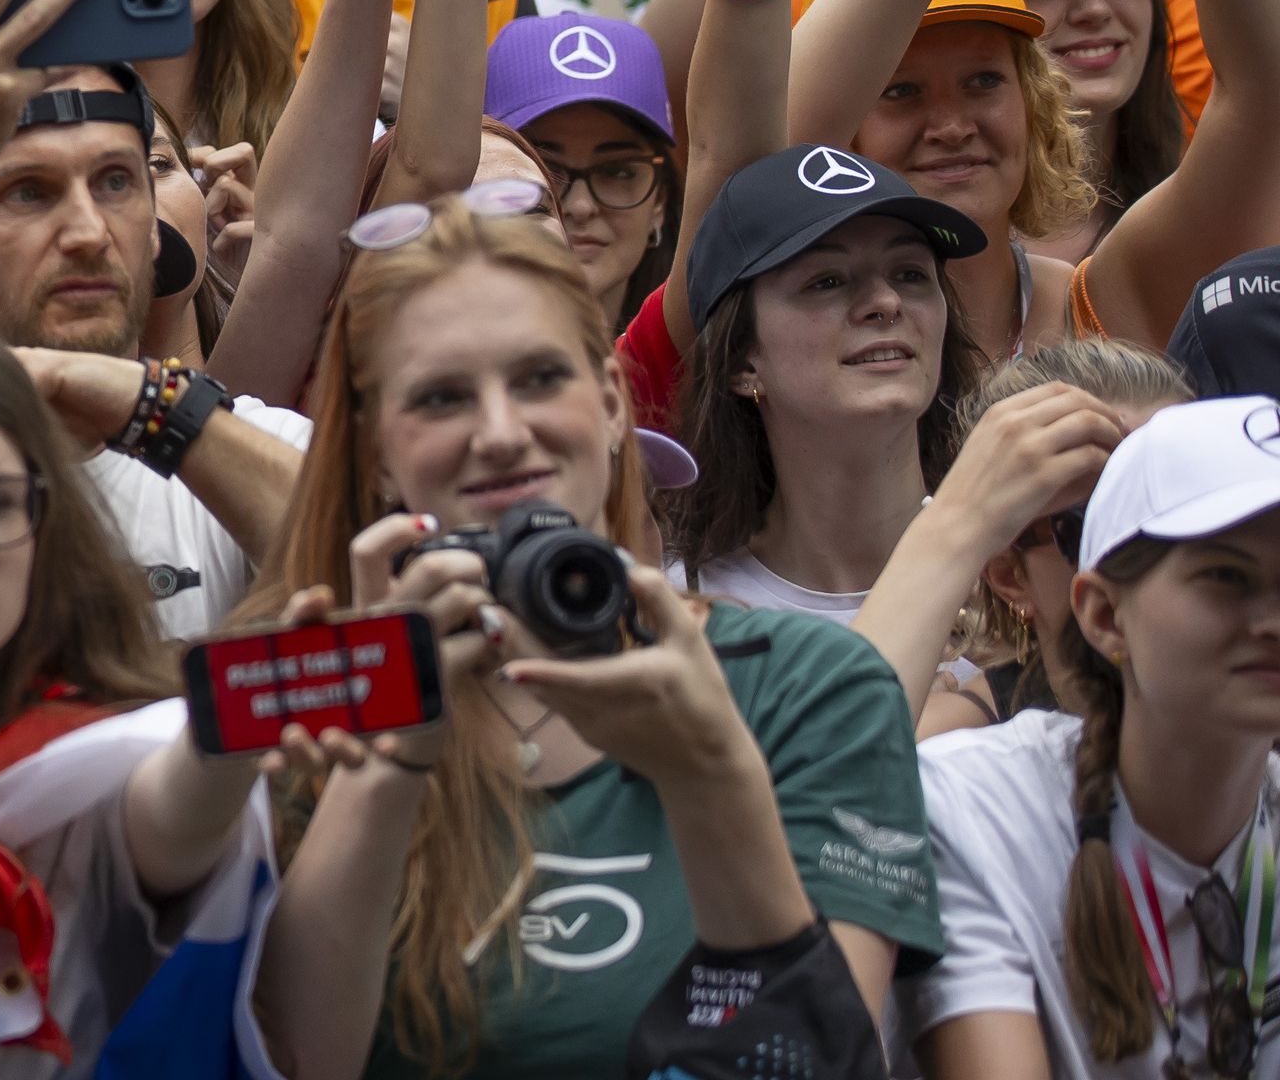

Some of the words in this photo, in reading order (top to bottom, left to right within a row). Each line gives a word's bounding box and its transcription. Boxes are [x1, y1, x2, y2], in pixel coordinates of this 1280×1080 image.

[1238, 275, 1280, 296] Mic
[819, 840, 875, 872] ASTON
[876, 860, 929, 891] MARTIN
